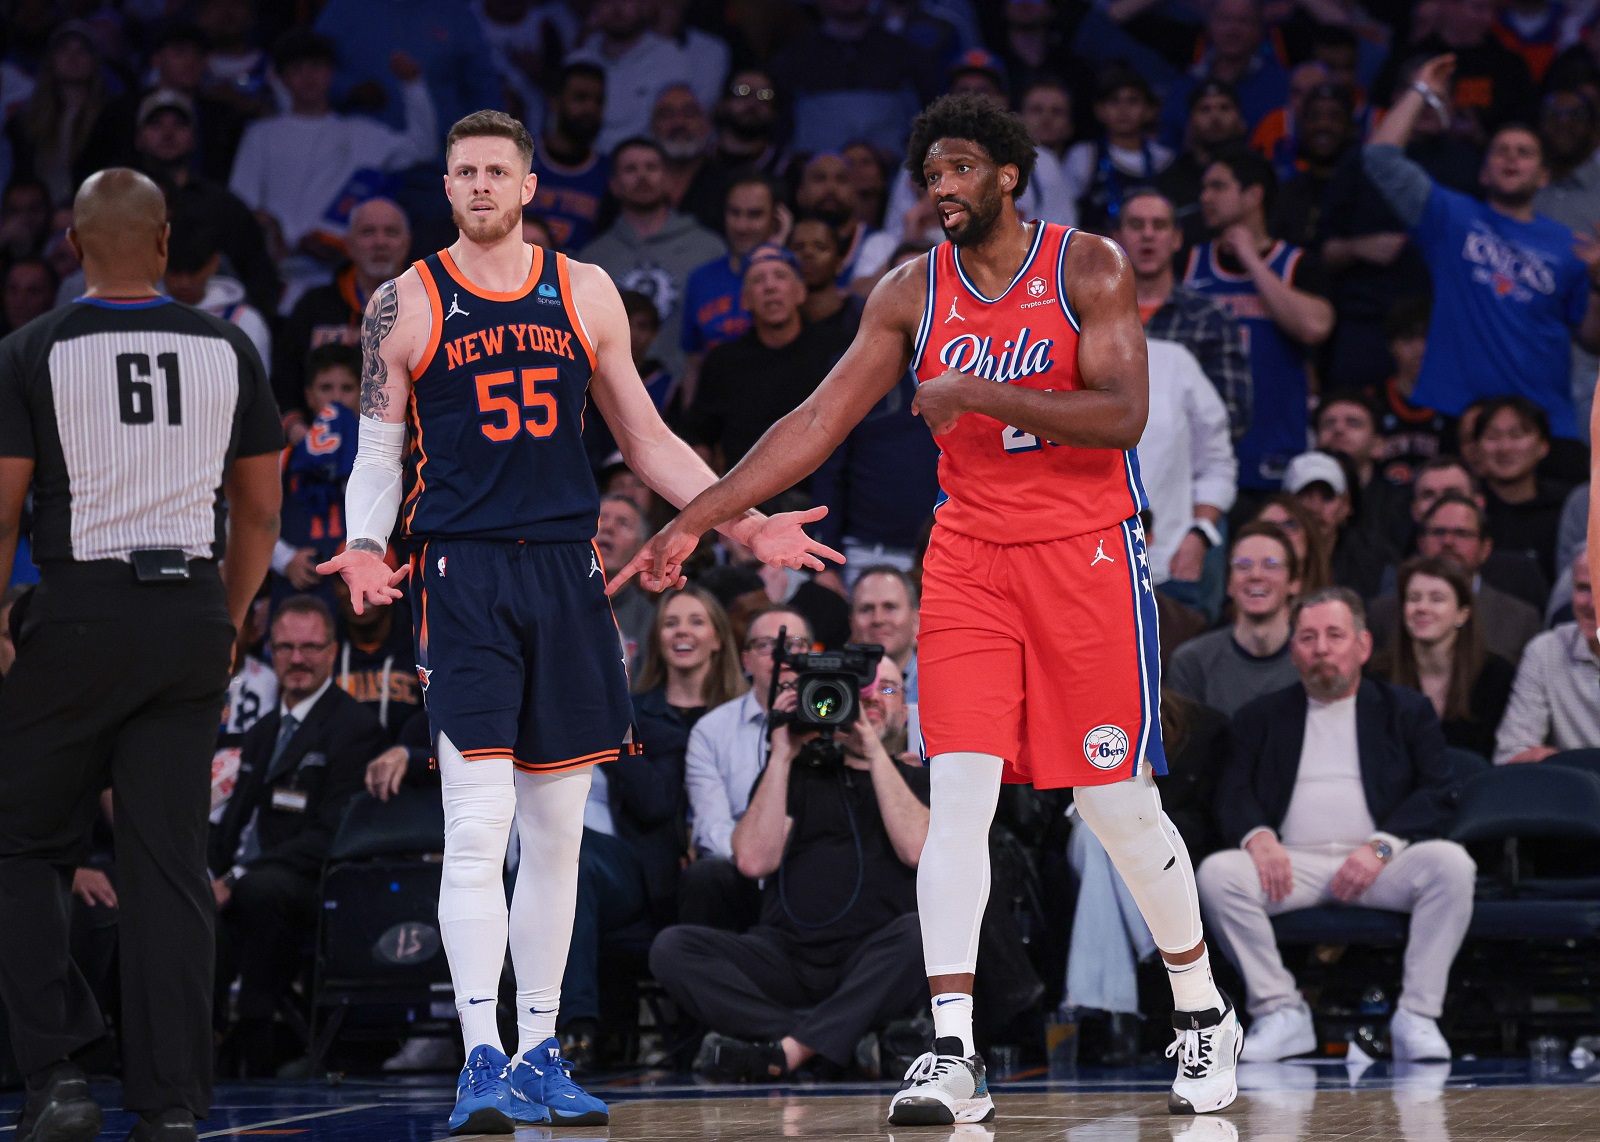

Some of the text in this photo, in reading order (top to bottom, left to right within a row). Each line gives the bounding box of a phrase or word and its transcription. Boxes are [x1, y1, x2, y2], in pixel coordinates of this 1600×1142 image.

[1020, 298, 1056, 309] crypto.com
[444, 323, 575, 371] NEW YORK
[939, 327, 1054, 383] Phila
[116, 352, 182, 425] 61
[473, 365, 559, 443] 55
[1088, 742, 1125, 758] 76ers
